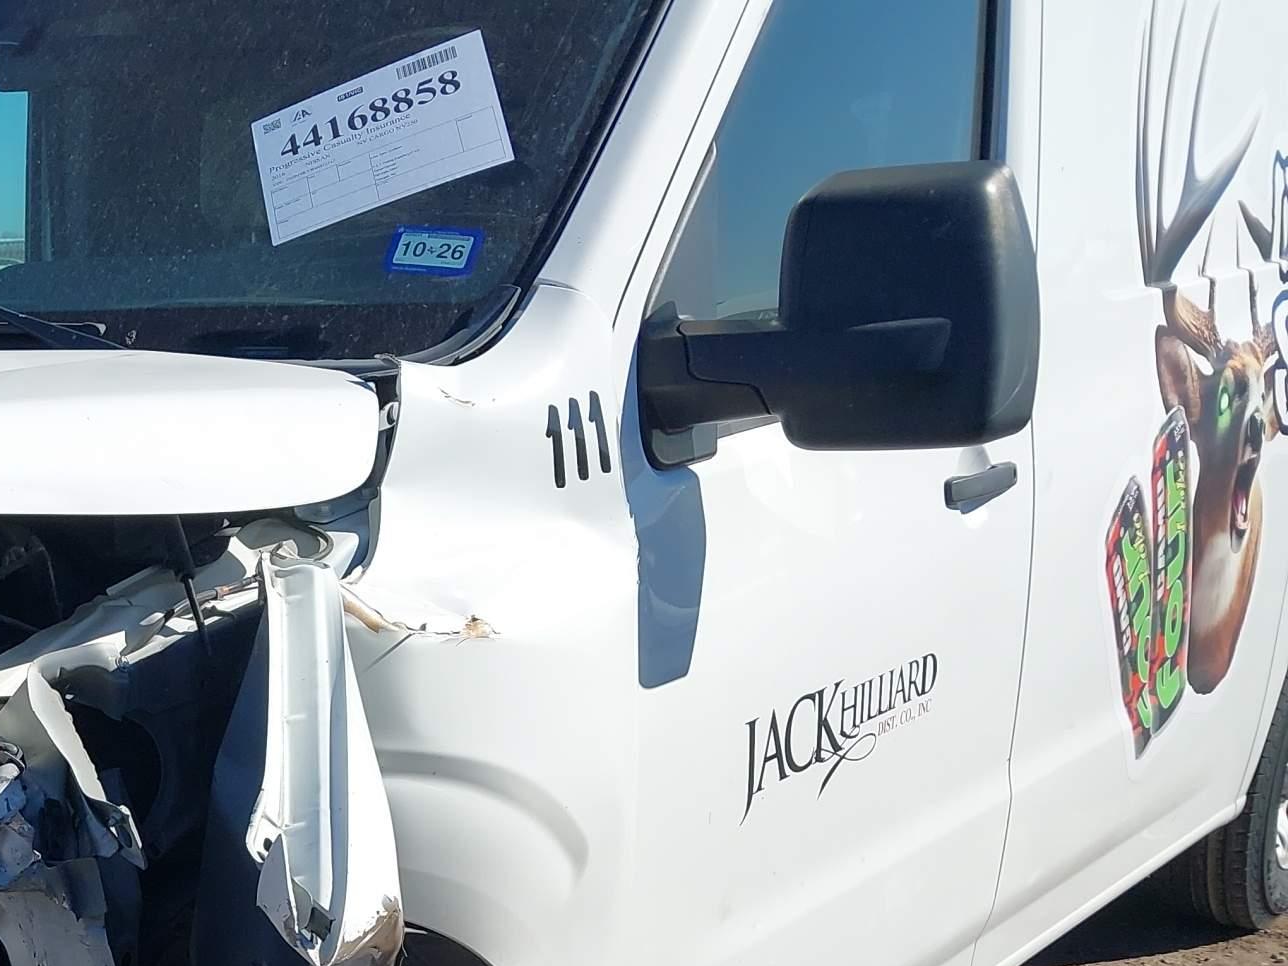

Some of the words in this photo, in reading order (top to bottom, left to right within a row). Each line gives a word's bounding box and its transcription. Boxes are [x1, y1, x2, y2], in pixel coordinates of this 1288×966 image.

[269, 149, 321, 175] Progressive
[323, 129, 363, 151] Casualty
[366, 113, 411, 135] Insurance
[280, 69, 462, 157] 44168858
[545, 390, 612, 488] 111
[739, 678, 845, 826] JACK
[839, 653, 938, 738] HILLIARD
